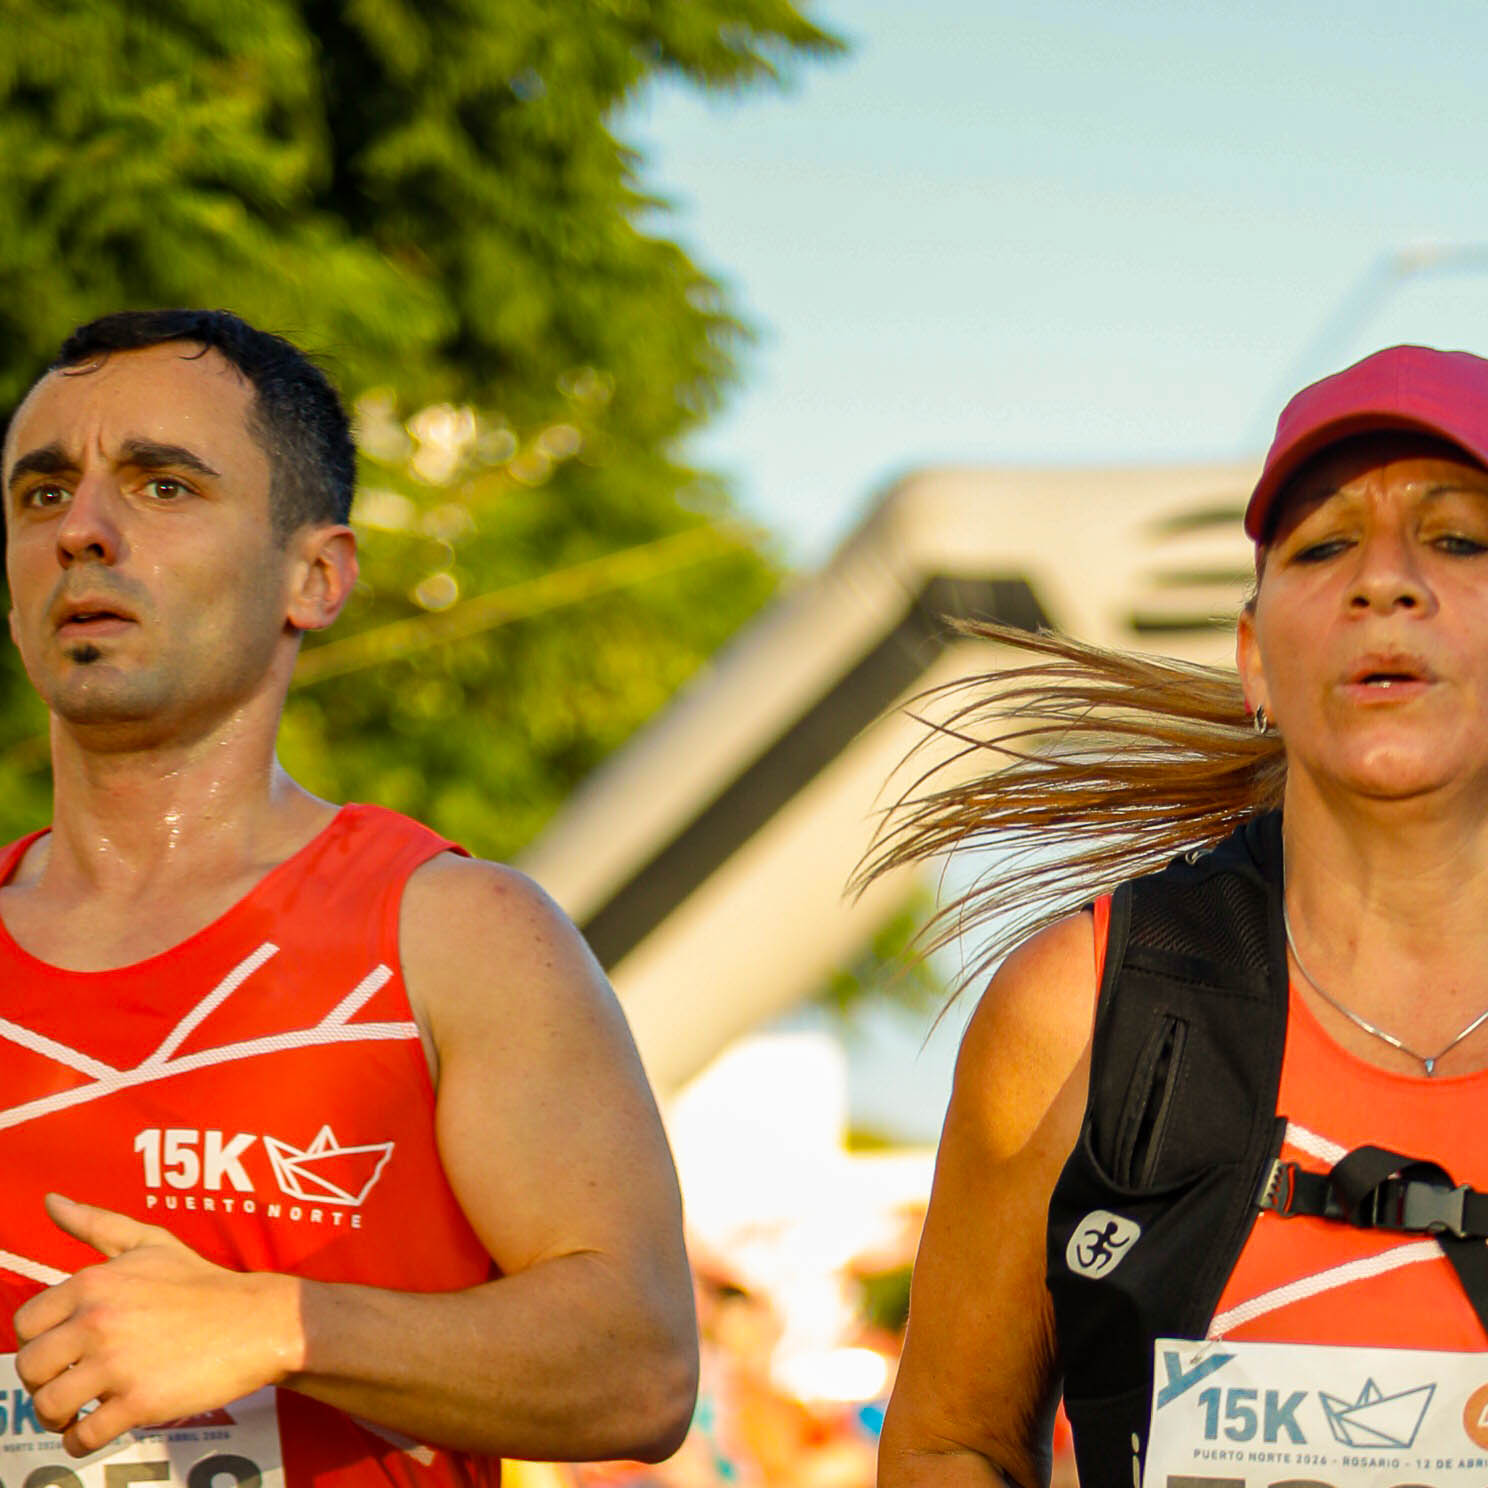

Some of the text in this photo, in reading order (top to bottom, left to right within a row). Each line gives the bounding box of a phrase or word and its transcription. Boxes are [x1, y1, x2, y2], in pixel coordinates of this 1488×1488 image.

[134, 1128, 258, 1192] 15K
[147, 1195, 361, 1229] PUERTO NORTE
[1197, 1387, 1309, 1445] 15K
[1193, 1448, 1244, 1462] PUERTO
[1248, 1452, 1291, 1464] NORTE
[1296, 1454, 1328, 1466] 2026
[1342, 1456, 1400, 1469] ROSARIO
[1436, 1458, 1452, 1470] DE
